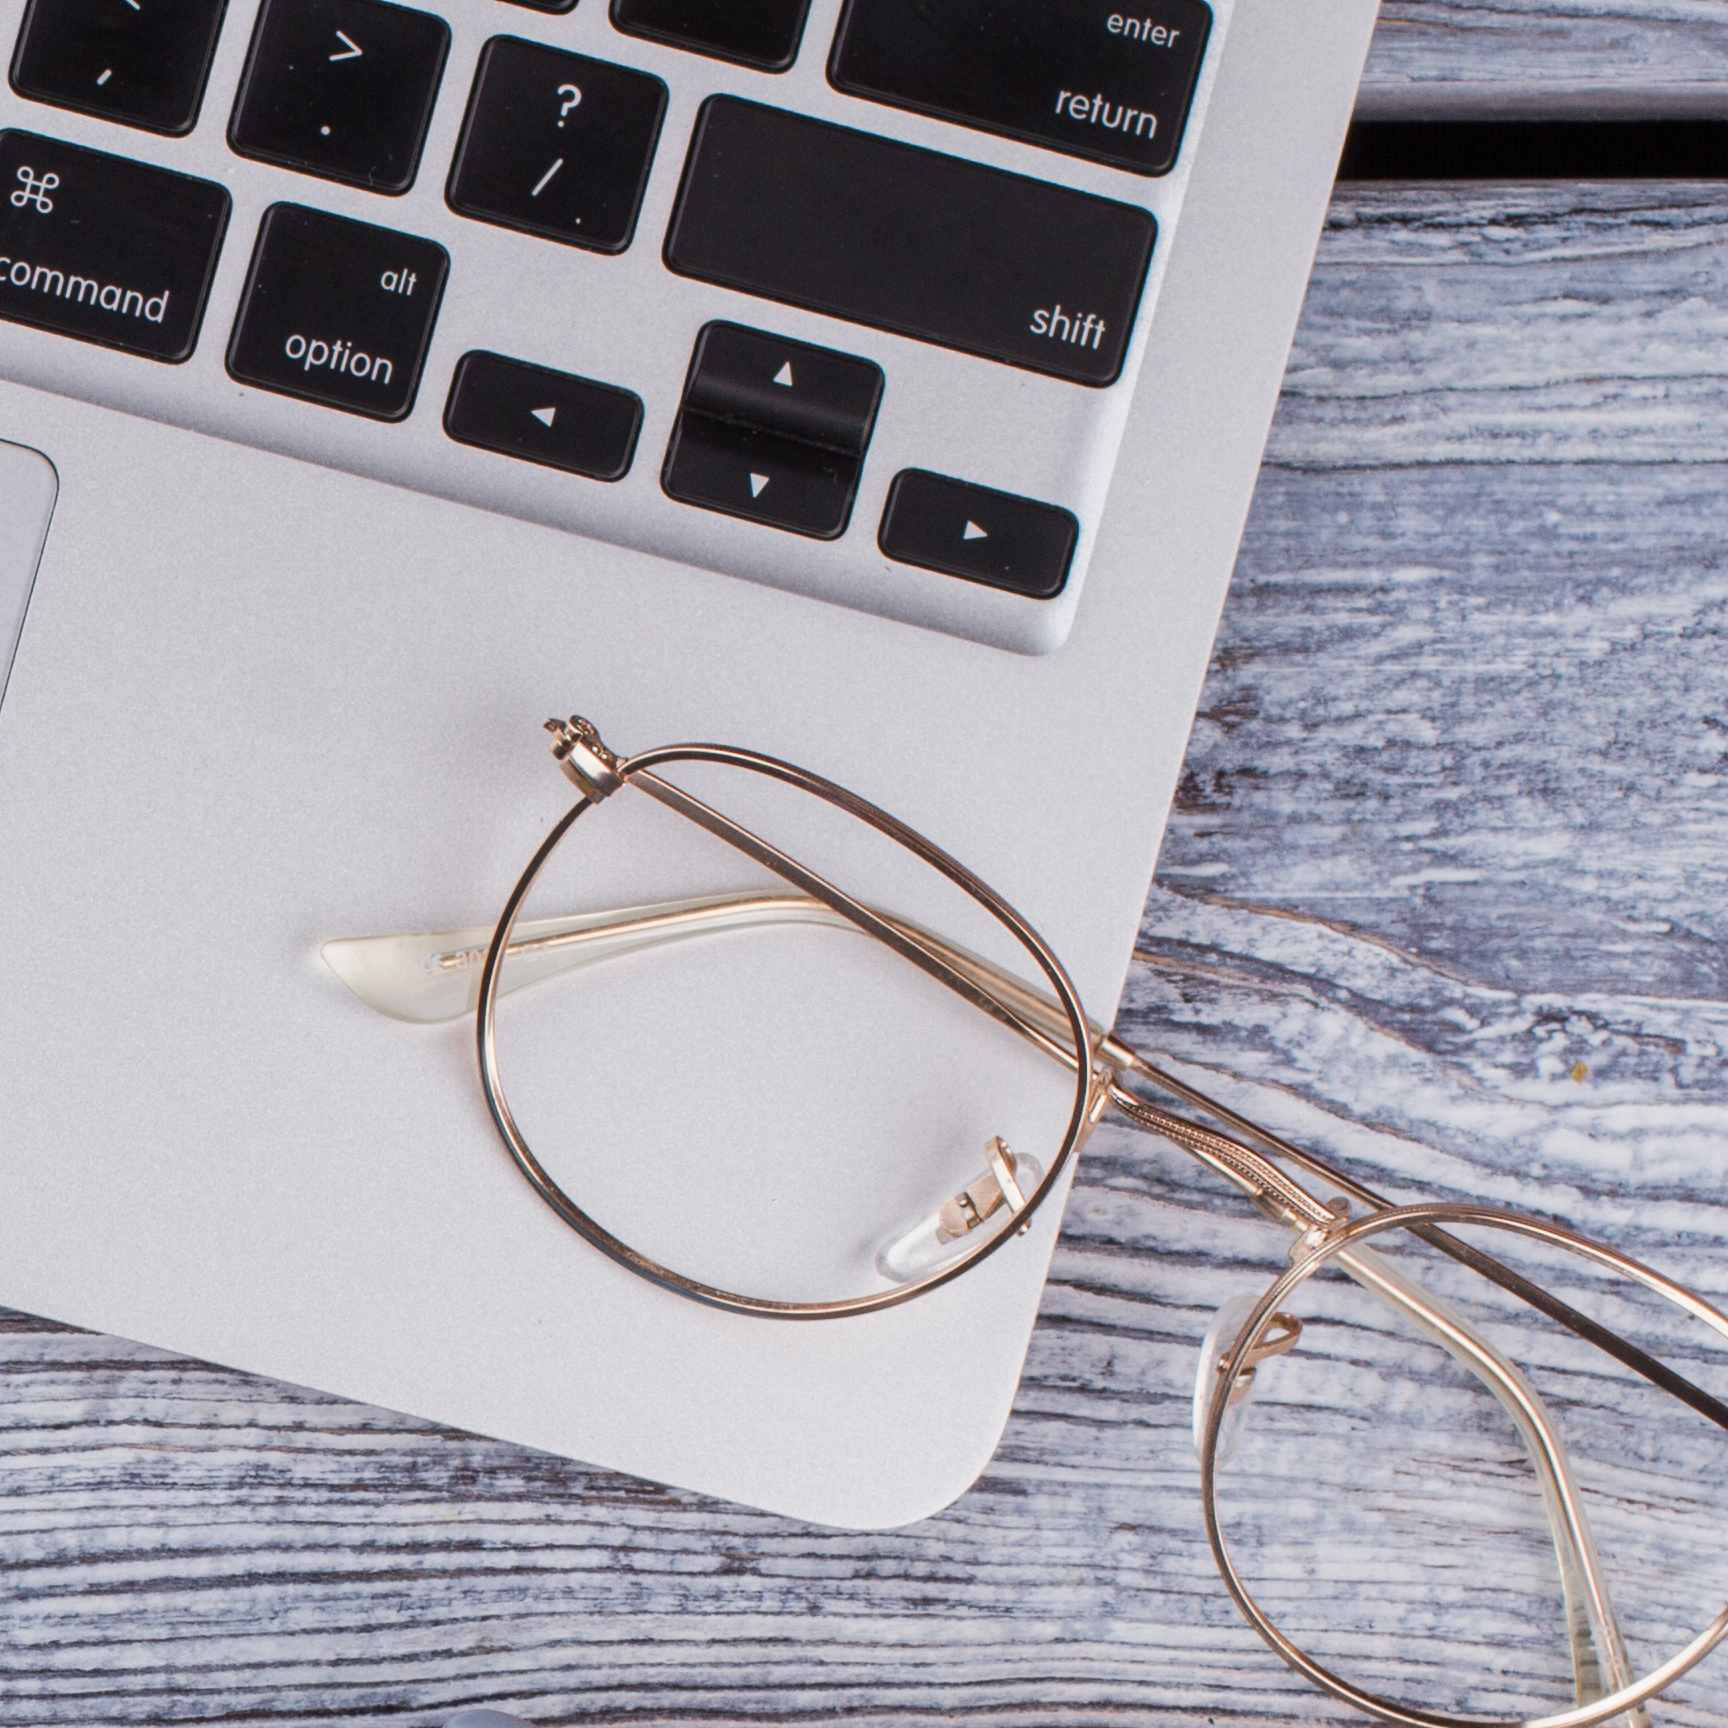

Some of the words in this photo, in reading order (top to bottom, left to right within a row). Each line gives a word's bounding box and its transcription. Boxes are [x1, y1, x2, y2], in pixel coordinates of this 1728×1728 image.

[1106, 13, 1181, 49] enter
[557, 83, 583, 128] ?
[1054, 89, 1158, 140] return
[379, 267, 418, 297] alt
[1028, 303, 1107, 351] shift
[284, 333, 394, 386] option
